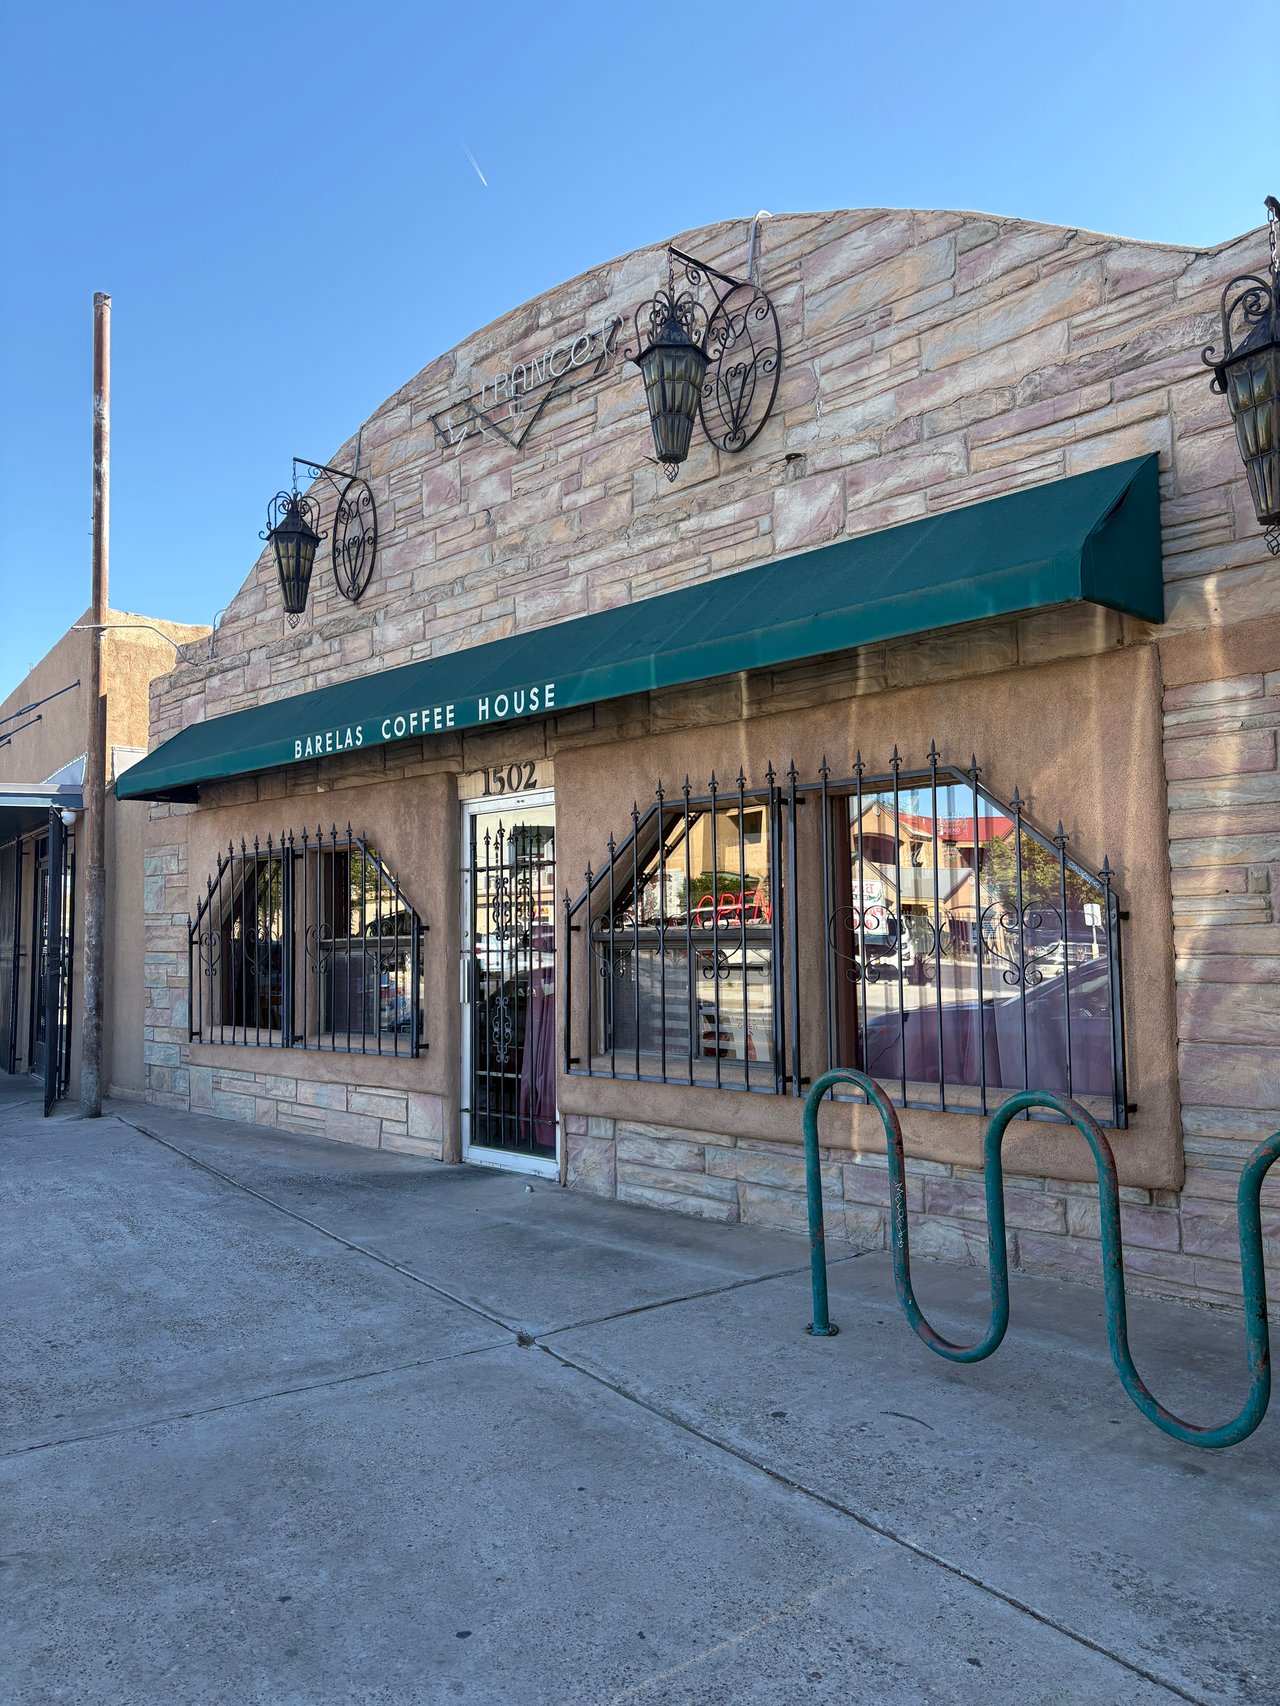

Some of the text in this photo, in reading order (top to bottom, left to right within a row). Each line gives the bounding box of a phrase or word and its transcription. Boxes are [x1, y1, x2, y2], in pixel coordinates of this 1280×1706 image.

[294, 684, 555, 759] BARELAS COFFEE HOUSE
[482, 761, 537, 796] 1502
[696, 890, 772, 927] OPEN
